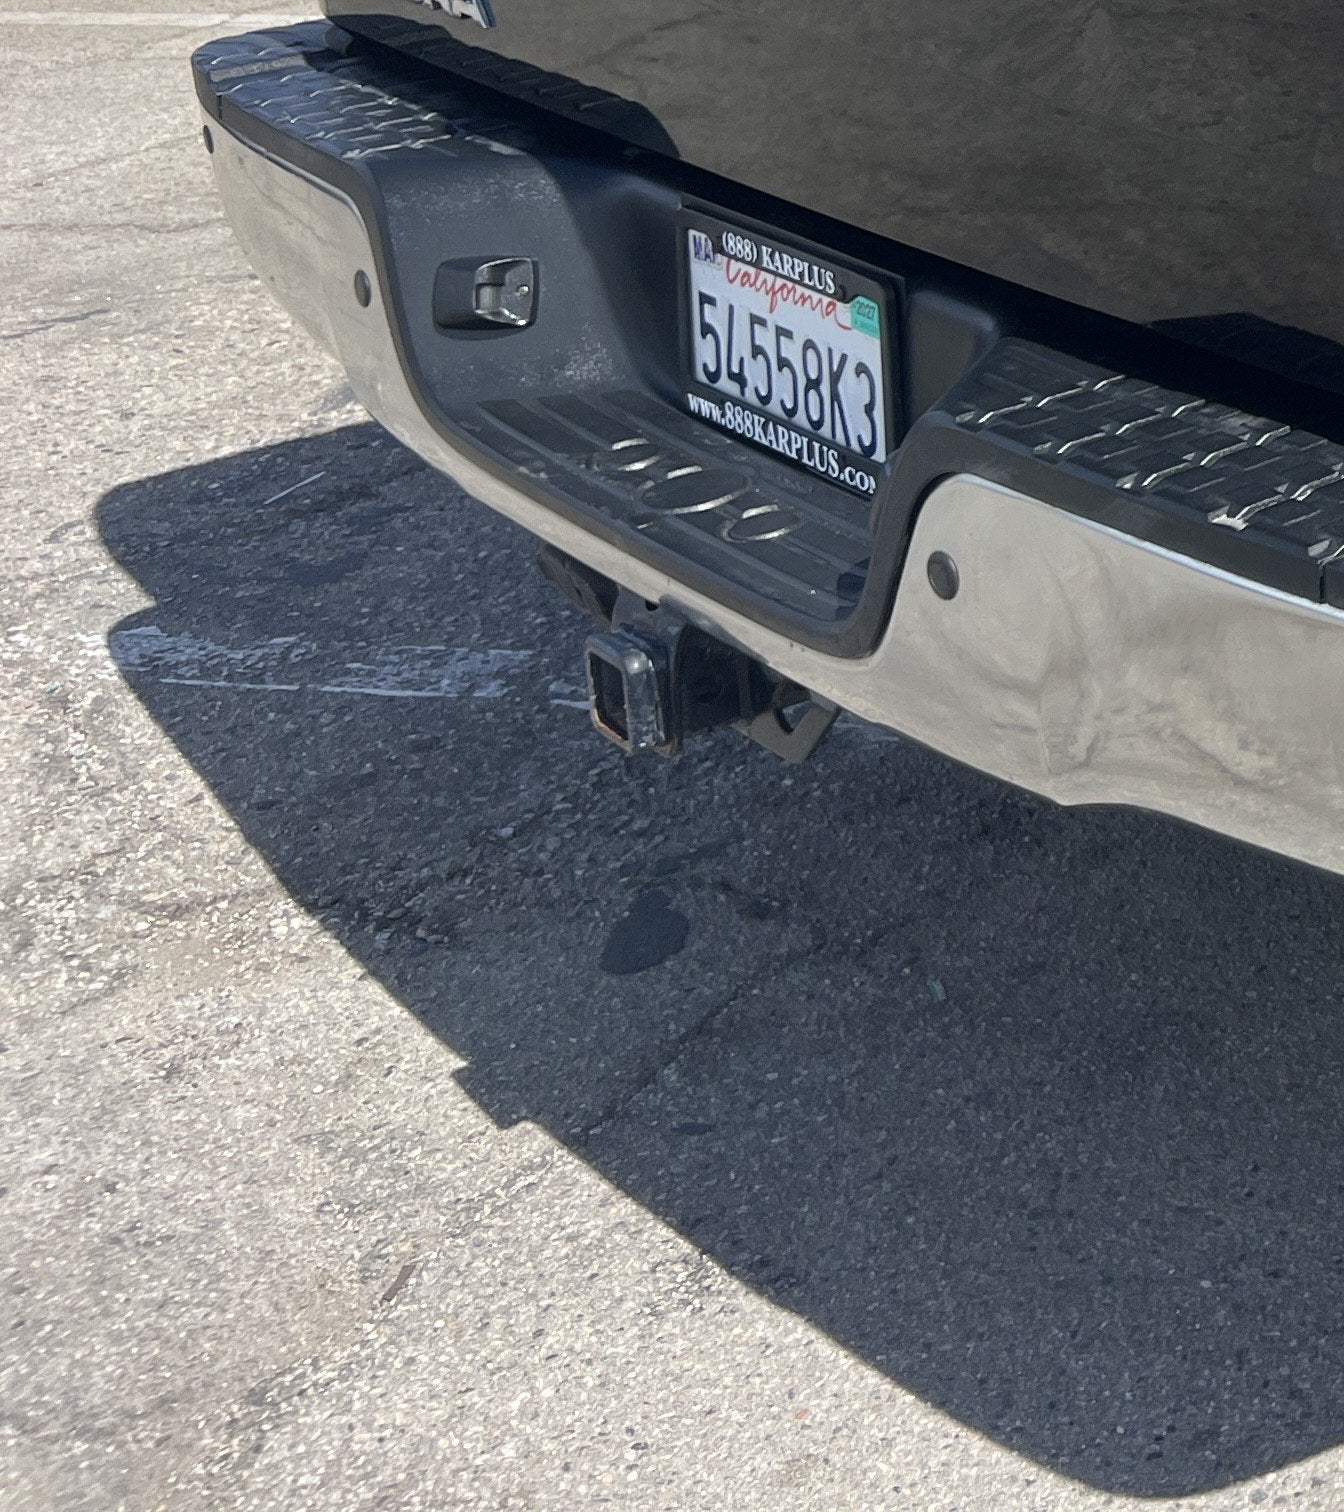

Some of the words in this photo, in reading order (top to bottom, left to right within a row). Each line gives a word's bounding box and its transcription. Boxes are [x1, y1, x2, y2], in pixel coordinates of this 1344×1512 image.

[721, 230, 758, 262] (888)
[760, 244, 836, 295] KARPLUS
[725, 258, 853, 331] California
[698, 289, 877, 458] 54558K3
